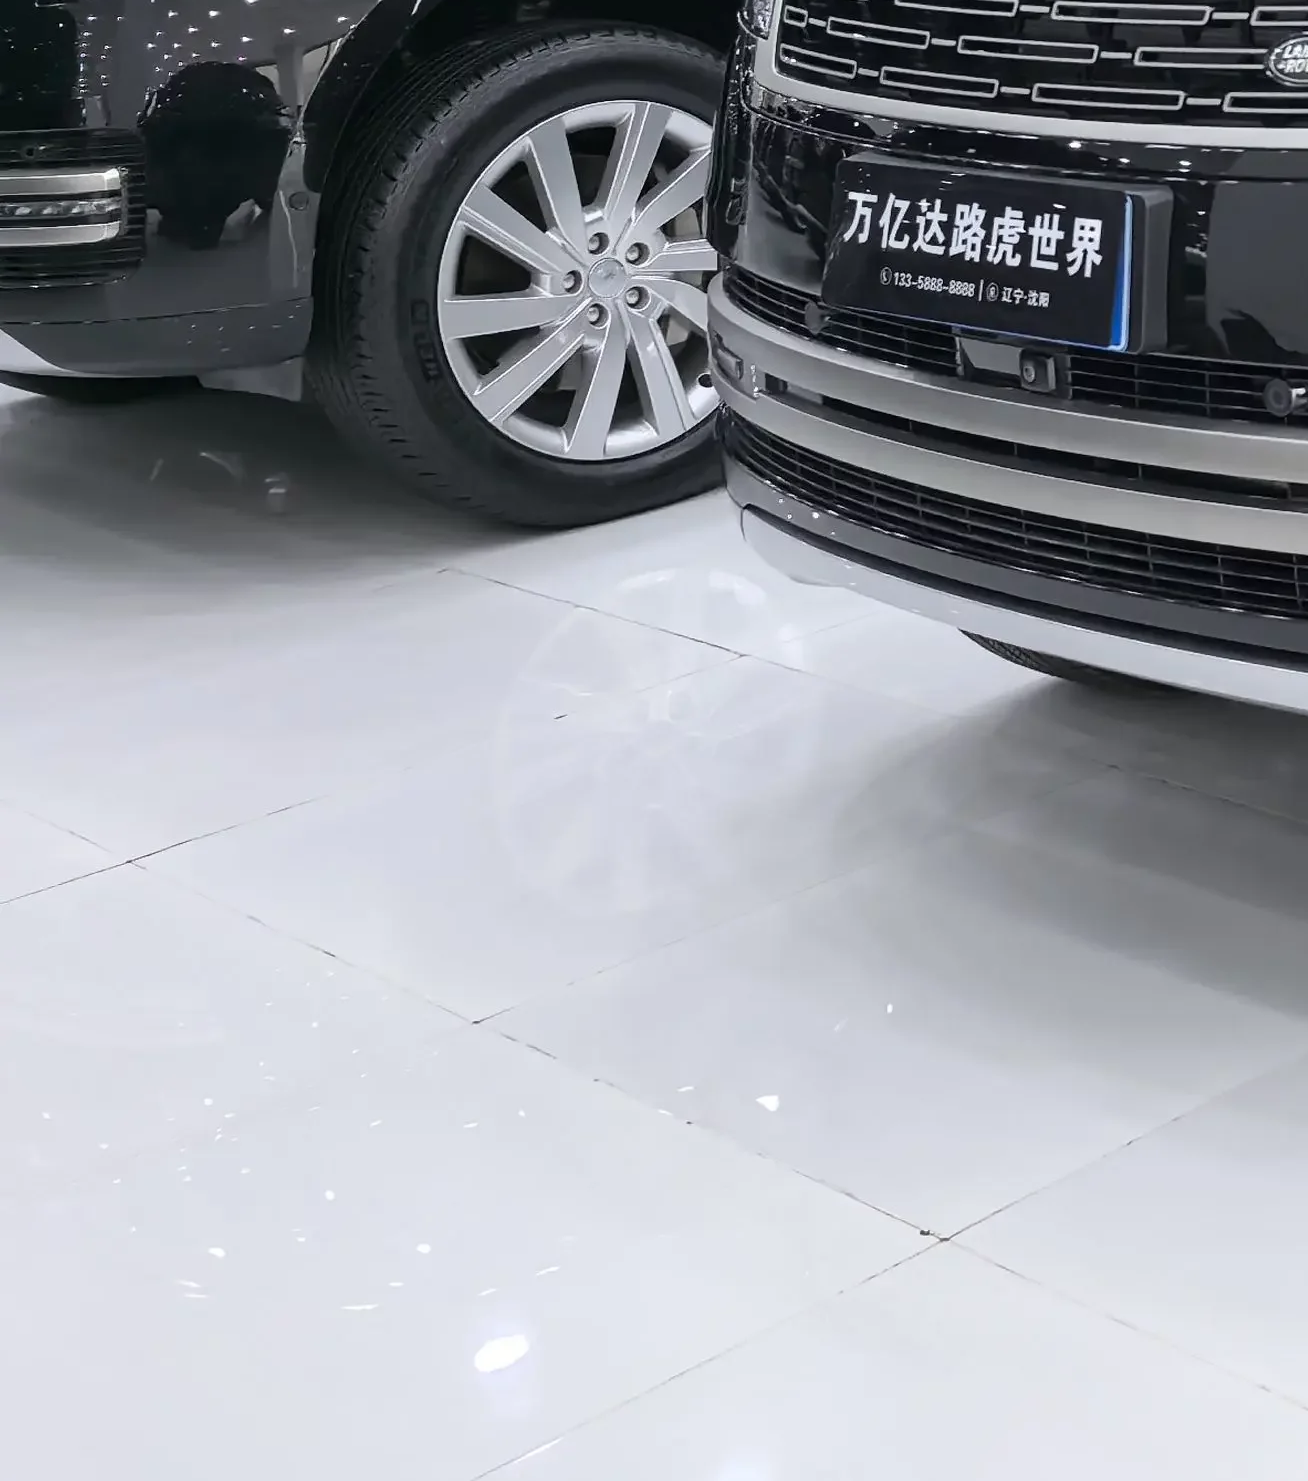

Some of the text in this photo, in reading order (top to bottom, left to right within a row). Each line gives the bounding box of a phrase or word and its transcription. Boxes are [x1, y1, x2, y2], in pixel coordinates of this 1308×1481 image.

[842, 190, 1103, 278] 万亿达路虎世界
